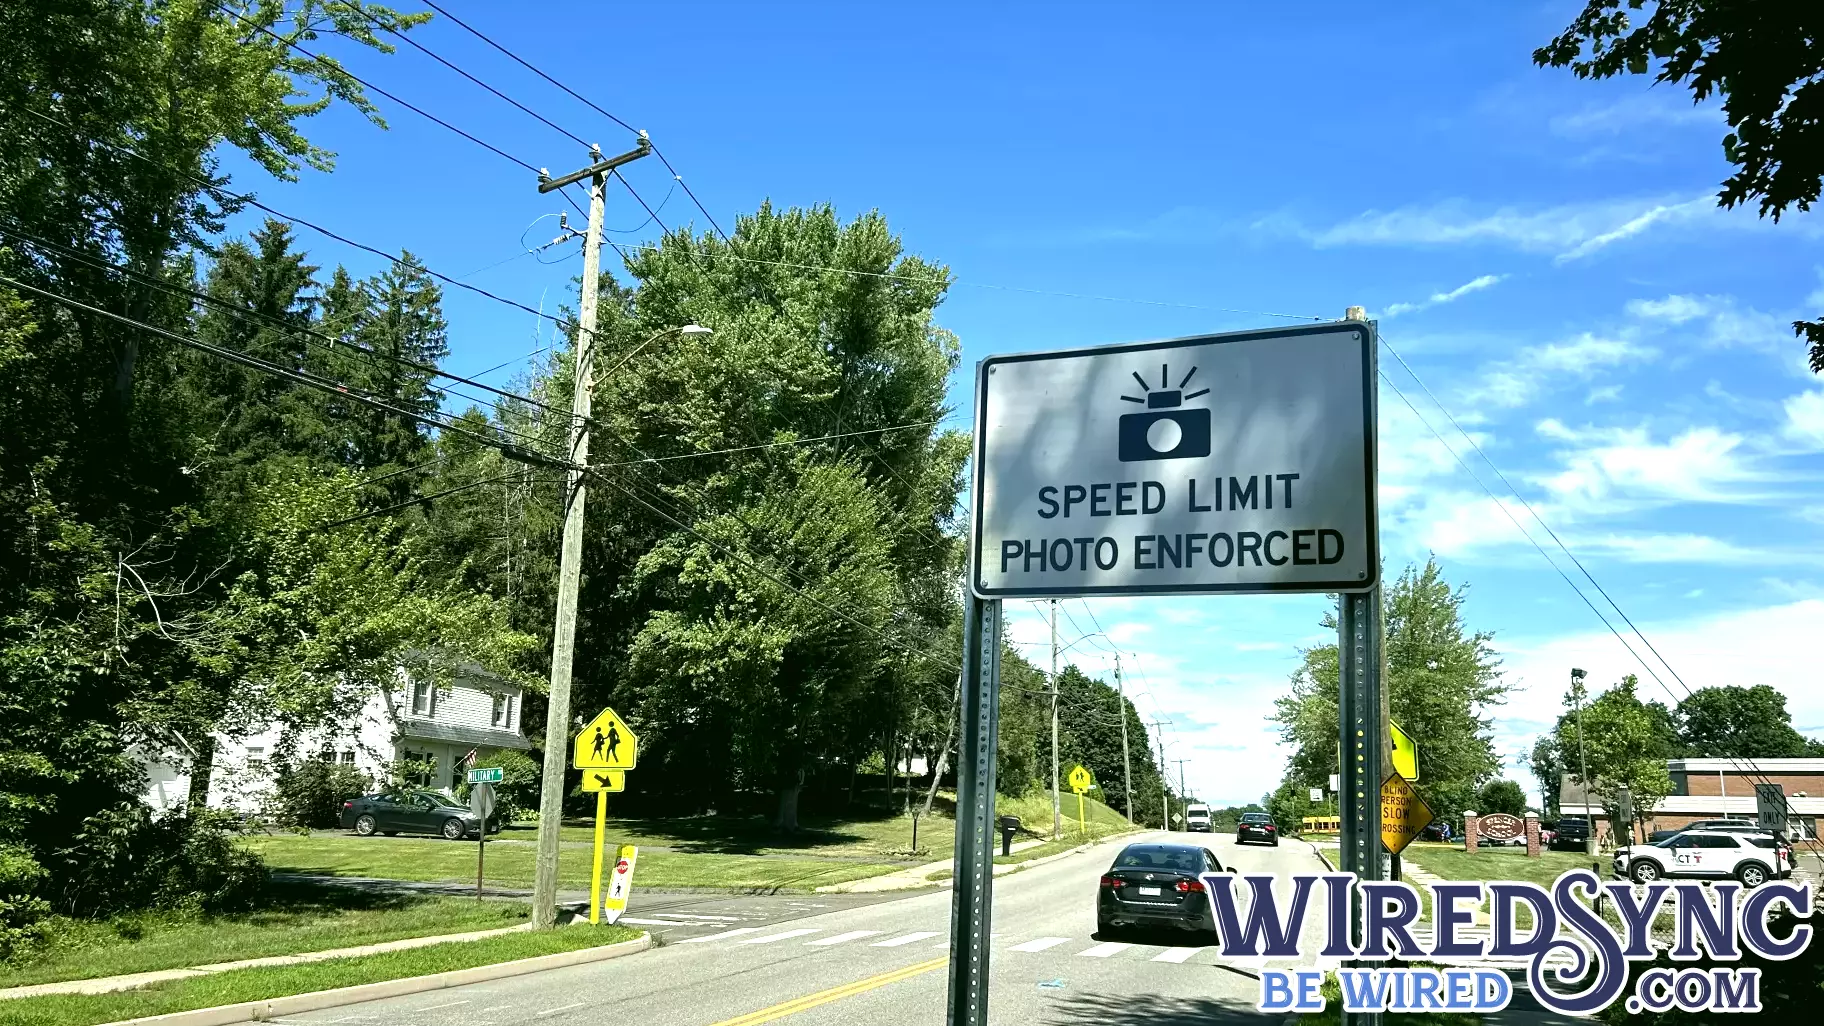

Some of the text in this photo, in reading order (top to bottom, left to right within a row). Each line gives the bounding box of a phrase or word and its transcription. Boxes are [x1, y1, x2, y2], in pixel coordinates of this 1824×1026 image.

[1037, 473, 1300, 519] SPEED LIMIT
[1001, 529, 1344, 573] PHOTO ENFORCED
[468, 770, 495, 781] MILITARY
[1384, 785, 1408, 795] BLIND
[1383, 806, 1410, 819] SLOW
[1763, 812, 1779, 824] ONLY
[1382, 823, 1416, 834] ROSSING
